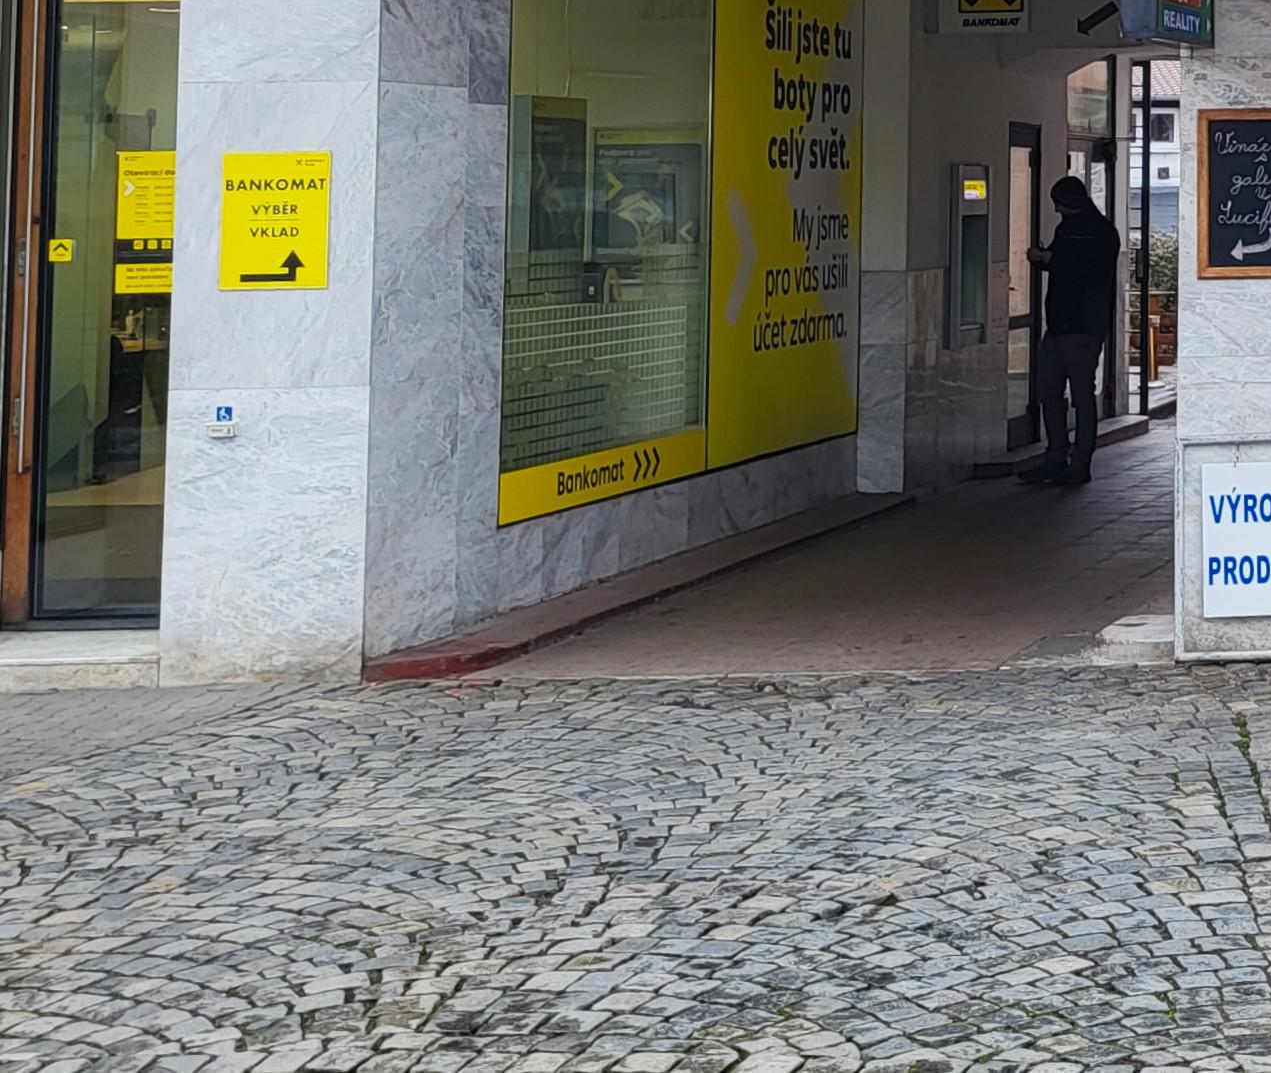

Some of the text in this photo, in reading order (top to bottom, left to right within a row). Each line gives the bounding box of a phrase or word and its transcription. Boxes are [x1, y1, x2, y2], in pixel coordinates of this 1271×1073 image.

[795, 10, 830, 63] jste
[834, 21, 852, 60] tu
[962, 17, 1021, 27] BANKOMAT
[1163, 9, 1201, 33] REALITY
[773, 69, 850, 124] boty pro
[767, 125, 851, 180] celý svět.
[225, 178, 327, 192] BANKOMAT
[251, 201, 299, 215] VÝBĚR
[792, 205, 849, 252] My jsme
[250, 226, 300, 238] VKLAD
[765, 252, 848, 307] pro vás ušili
[753, 307, 847, 352] účet zdarma.
[556, 458, 625, 496] Bankomat
